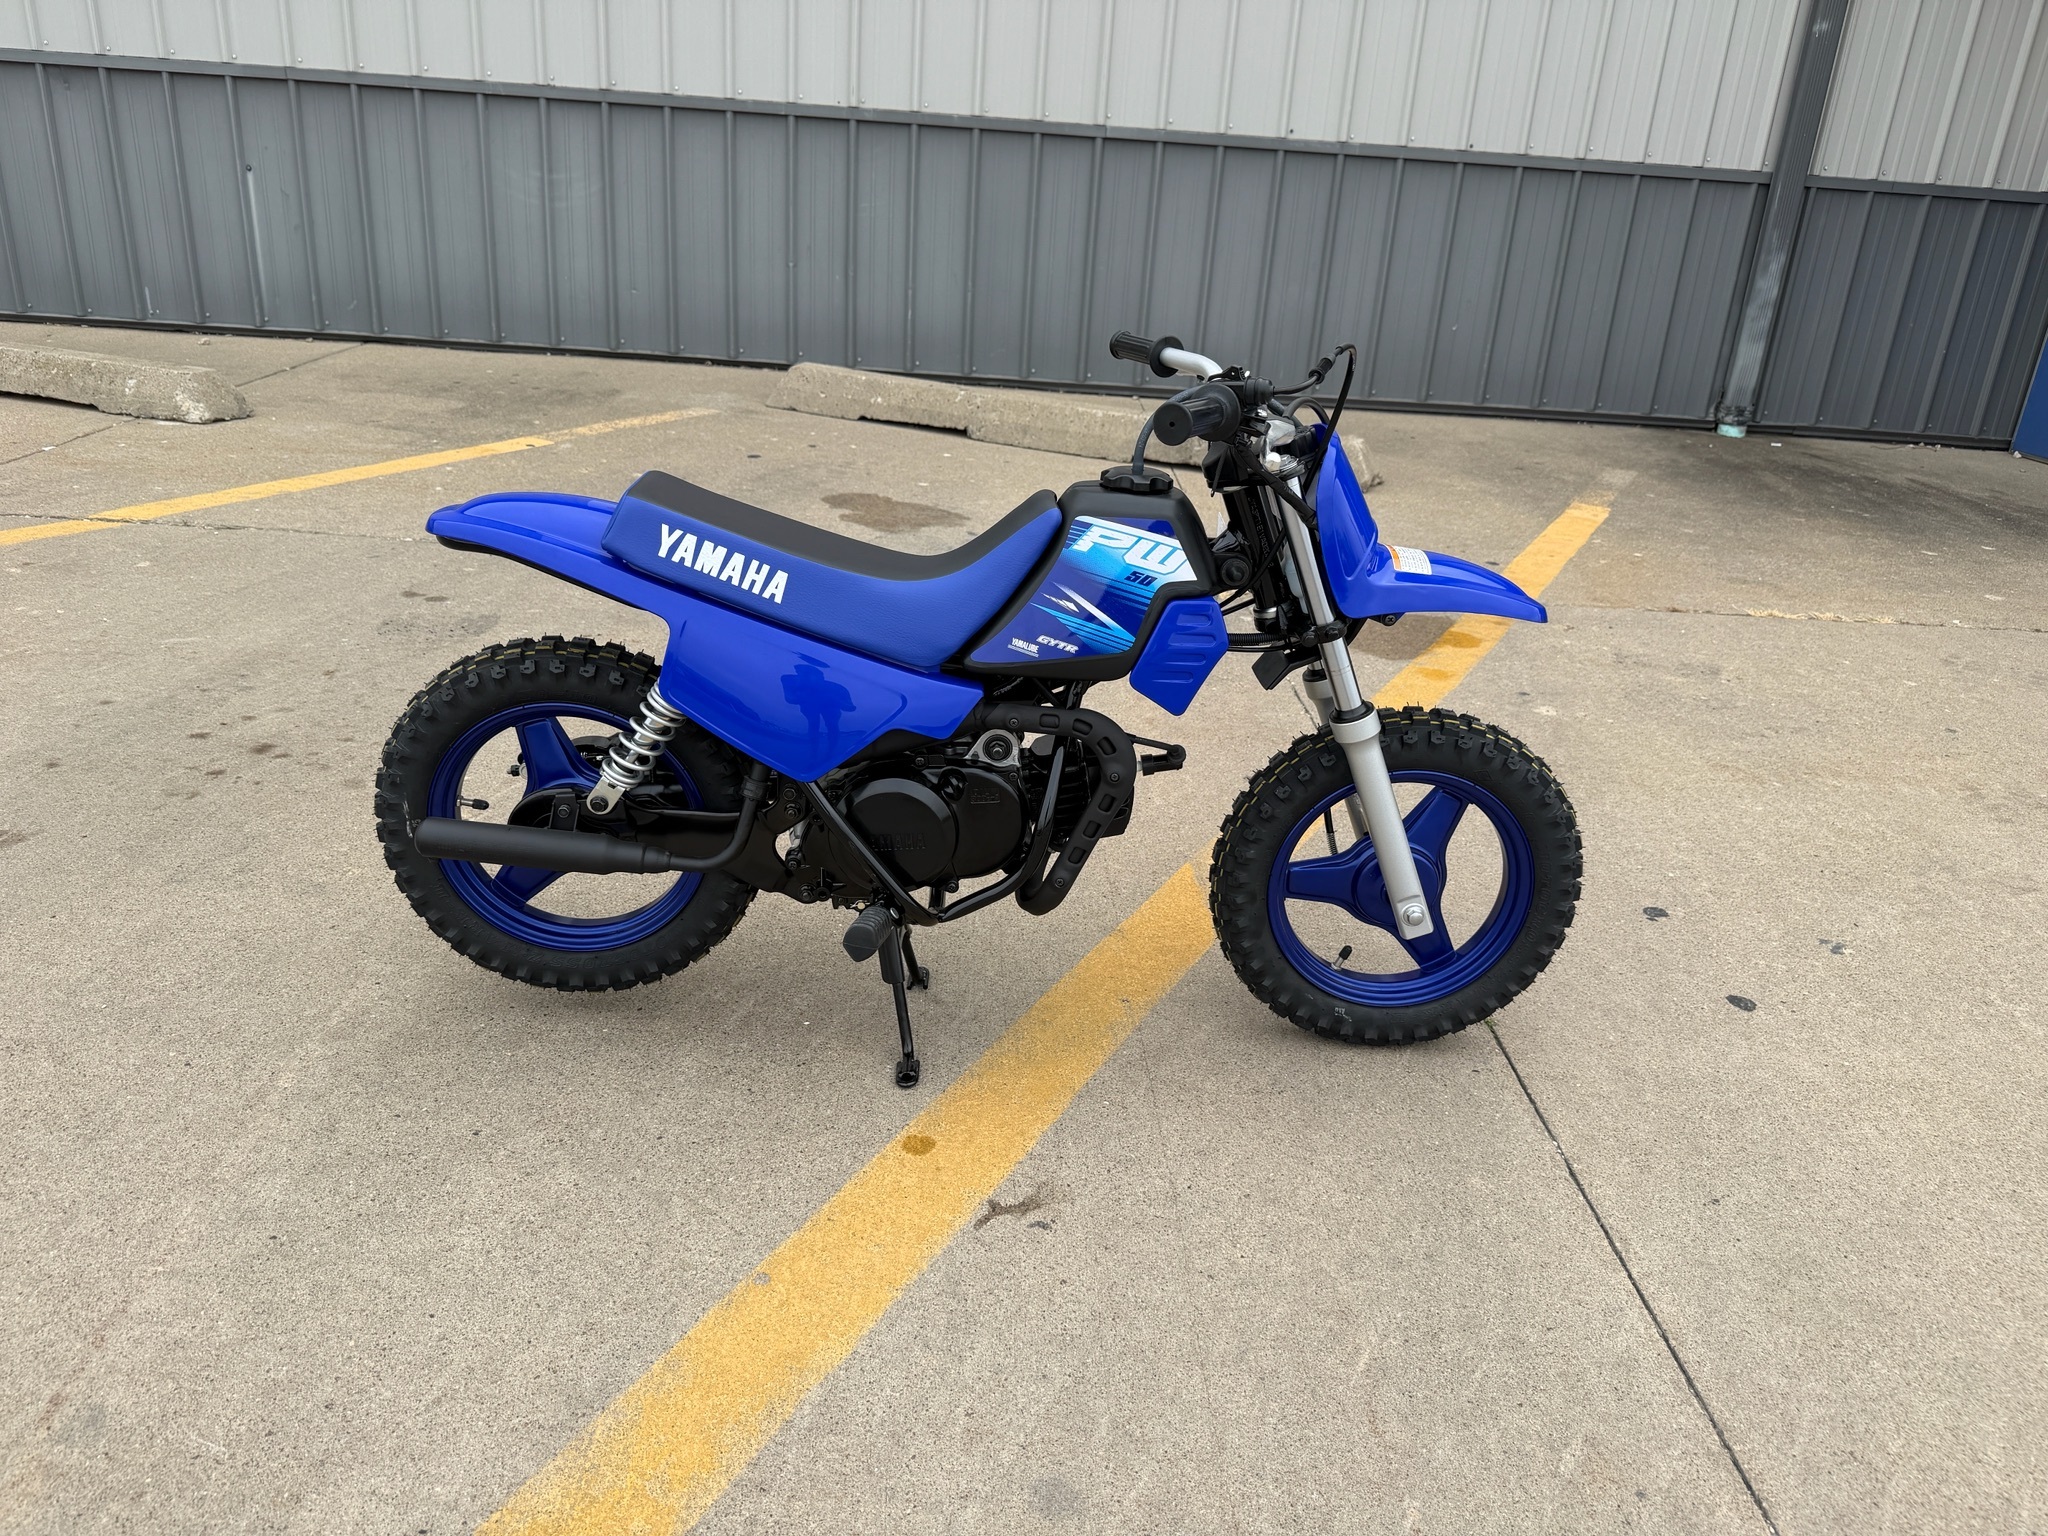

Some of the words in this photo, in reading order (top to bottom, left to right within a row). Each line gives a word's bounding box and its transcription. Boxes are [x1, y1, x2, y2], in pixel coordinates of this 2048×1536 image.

[658, 523, 789, 604] YAMAHA
[1071, 524, 1187, 575] PW
[1124, 570, 1158, 587] 50
[1036, 634, 1079, 654] GYTR
